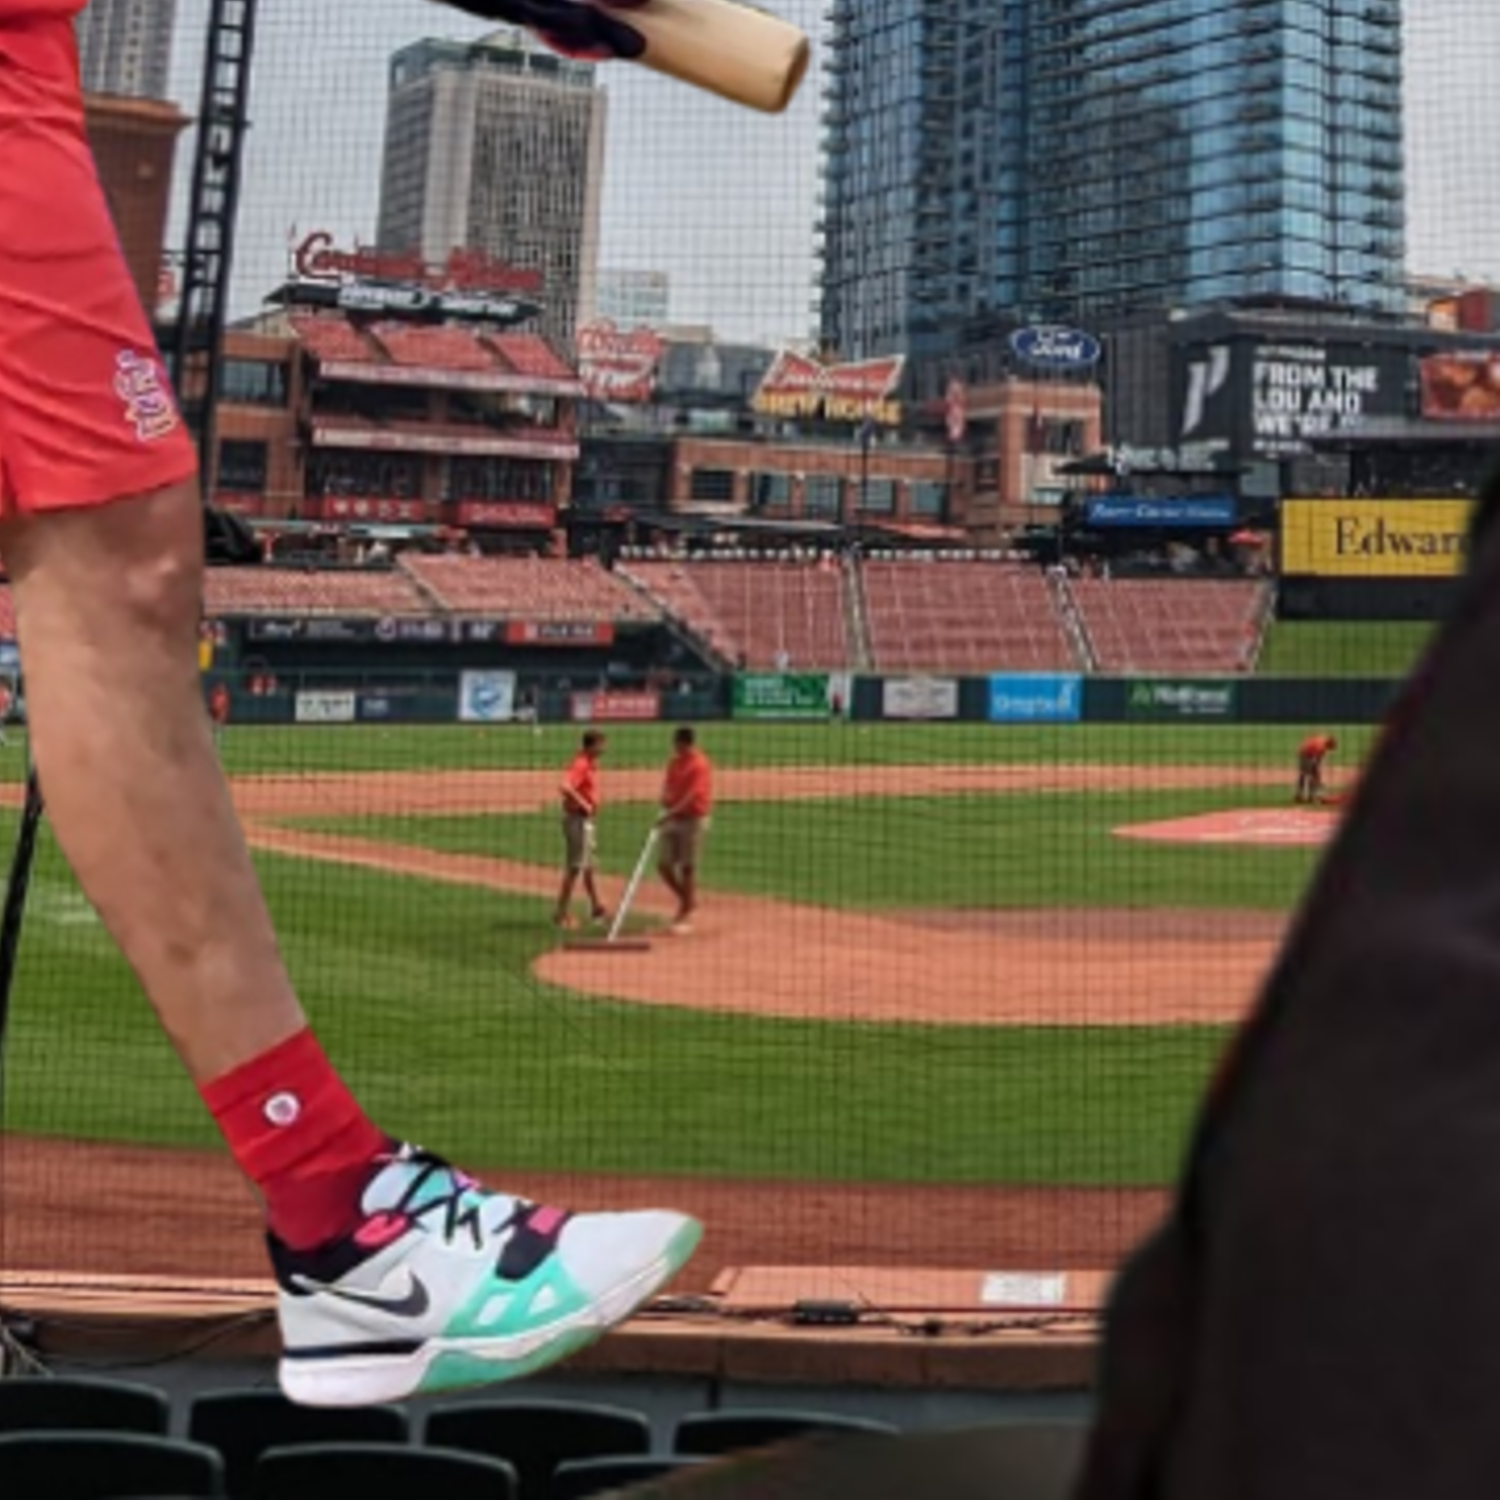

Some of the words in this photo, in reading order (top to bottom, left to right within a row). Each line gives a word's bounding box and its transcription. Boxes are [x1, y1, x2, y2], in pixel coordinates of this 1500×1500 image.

[1253, 362, 1326, 389] FROM
[1329, 366, 1378, 392] THE
[1253, 386, 1301, 412] LOU
[1307, 391, 1361, 415] AND
